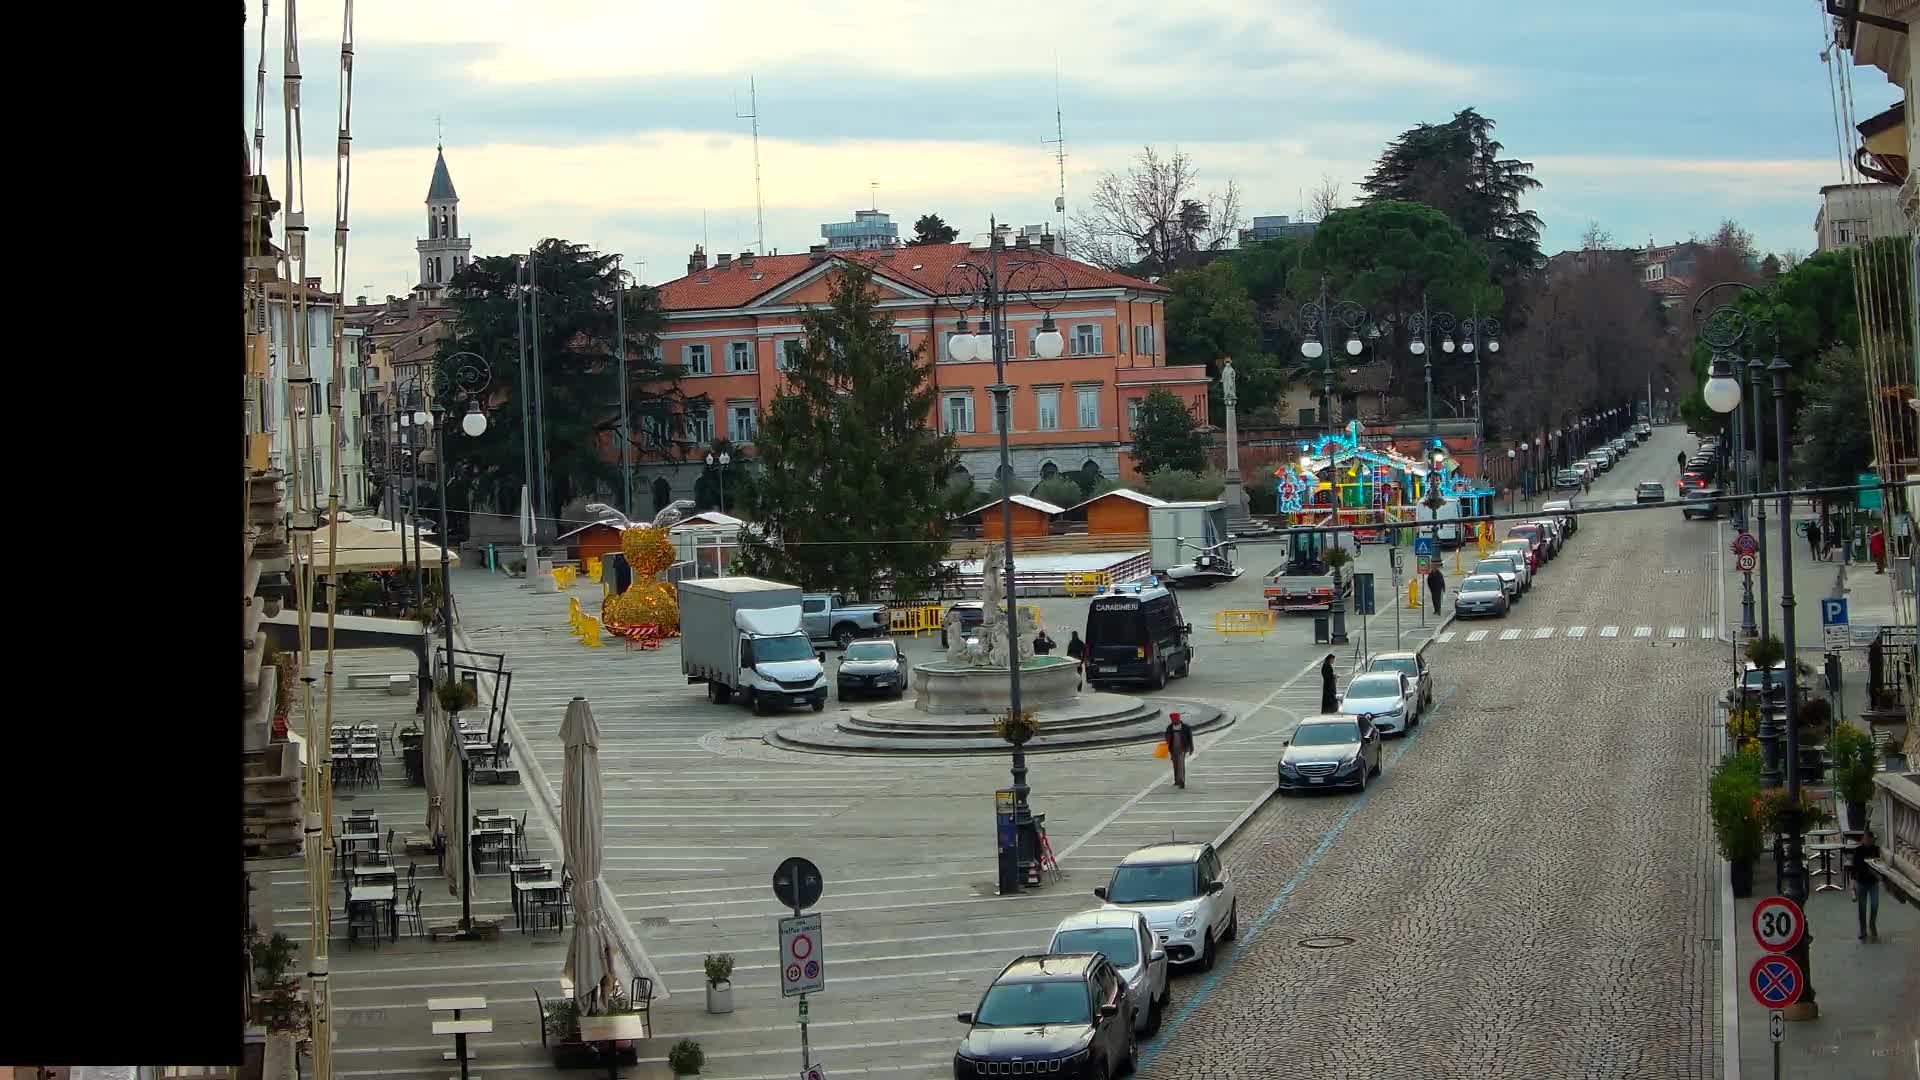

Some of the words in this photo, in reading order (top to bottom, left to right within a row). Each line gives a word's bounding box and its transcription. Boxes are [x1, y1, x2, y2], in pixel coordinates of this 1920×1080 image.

[1742, 557, 1753, 567] 20
[1095, 603, 1139, 612] CARABINIERI
[1827, 602, 1842, 622] P
[1762, 911, 1792, 938] 30
